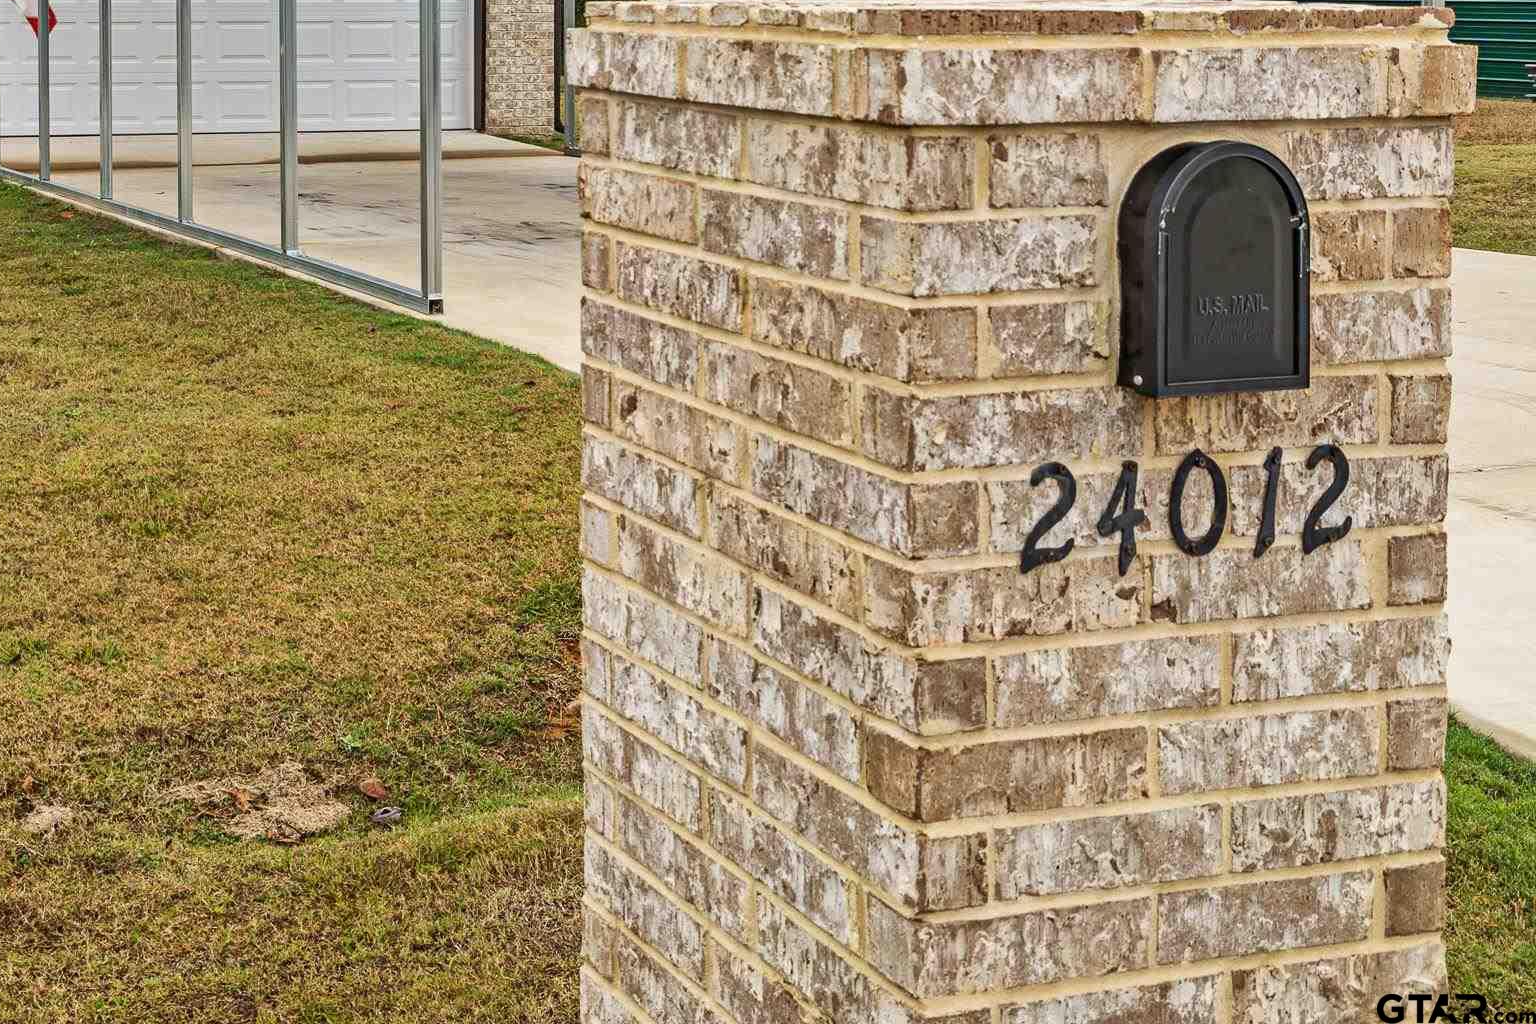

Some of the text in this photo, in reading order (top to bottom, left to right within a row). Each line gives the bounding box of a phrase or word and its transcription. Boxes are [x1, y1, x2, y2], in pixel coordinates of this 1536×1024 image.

[1197, 292, 1270, 316] U.S. MAIL
[1019, 443, 1353, 576] 24012
